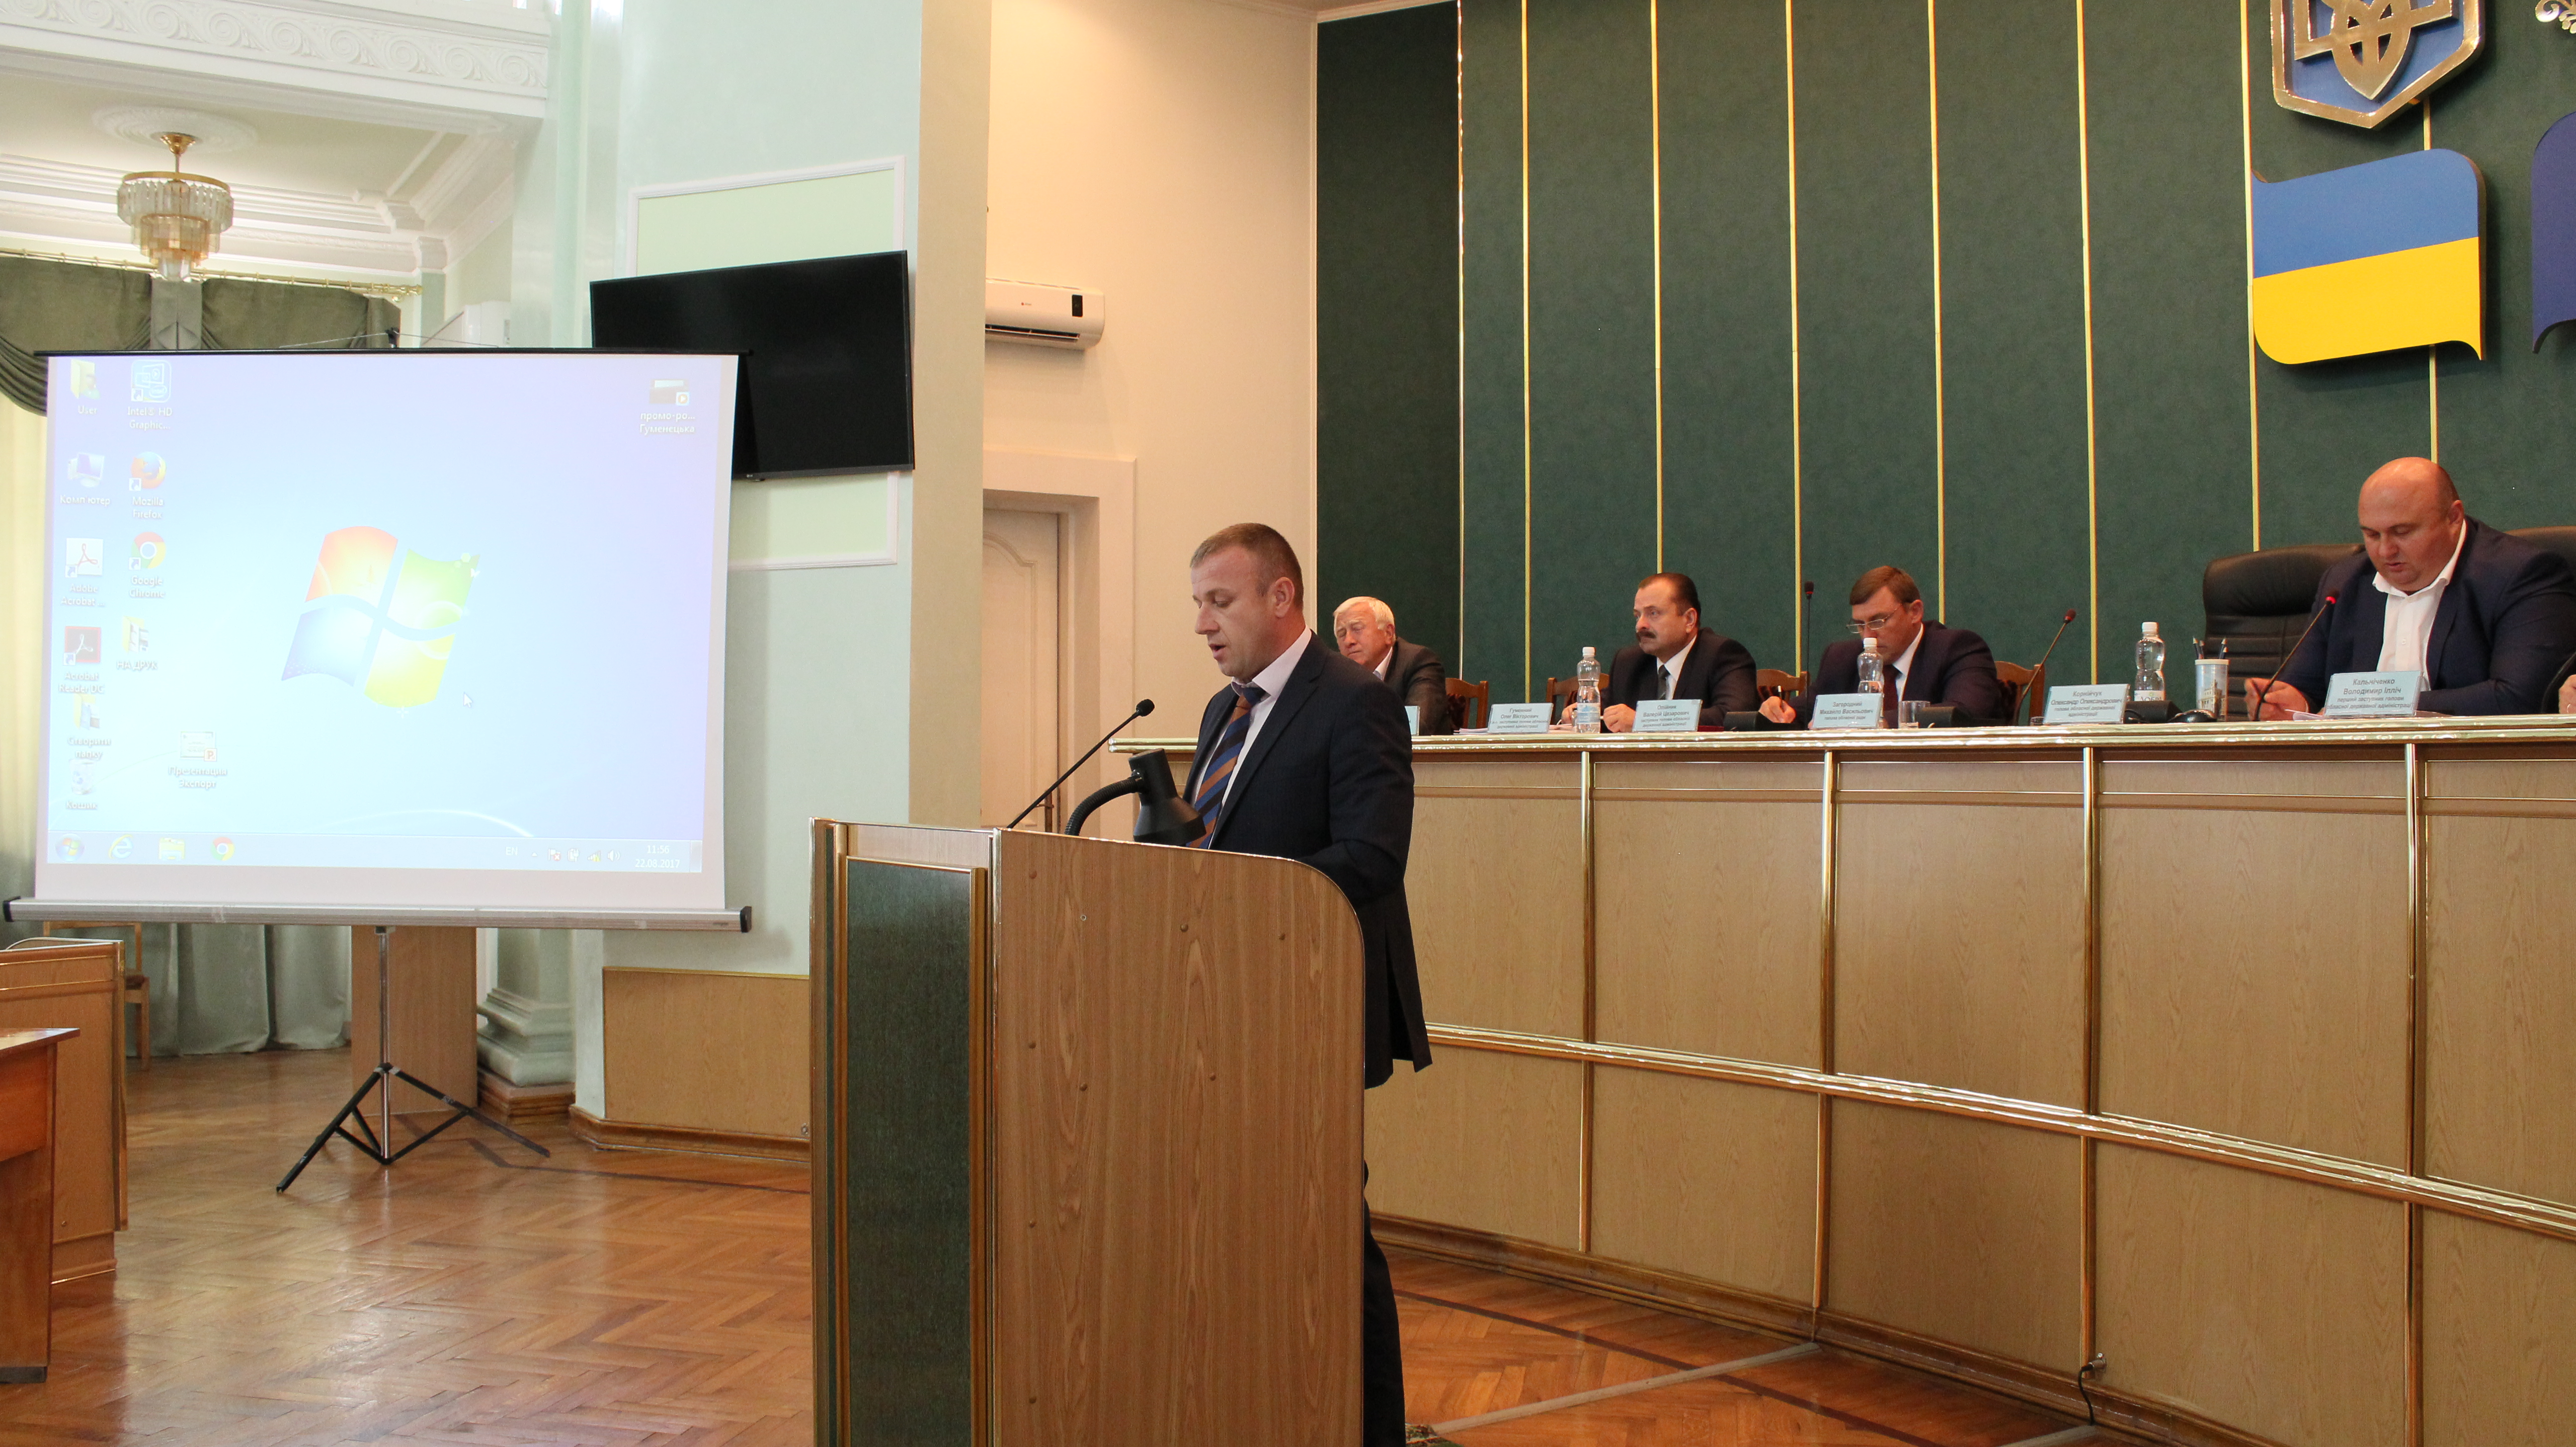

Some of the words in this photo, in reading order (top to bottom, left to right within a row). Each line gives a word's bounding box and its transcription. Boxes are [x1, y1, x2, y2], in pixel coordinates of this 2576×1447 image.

[78, 405, 98, 414] User
[159, 407, 172, 416] HD
[640, 424, 695, 435] Гуменецька
[133, 497, 164, 506] Mozilla
[133, 509, 162, 519] Firefox
[131, 575, 163, 587] Google
[70, 583, 98, 593] Adobe
[129, 589, 165, 598] Chrome
[61, 596, 95, 606] Acrobat
[117, 661, 130, 669] НА
[133, 661, 158, 670] ДРУК
[65, 672, 99, 681] Acrobat
[59, 684, 88, 693] Reader
[179, 779, 217, 790] Экспорт
[66, 801, 97, 809] Кошик
[505, 847, 518, 856] EN
[647, 845, 669, 854] 11:56
[635, 859, 680, 869] 22.08.2017
